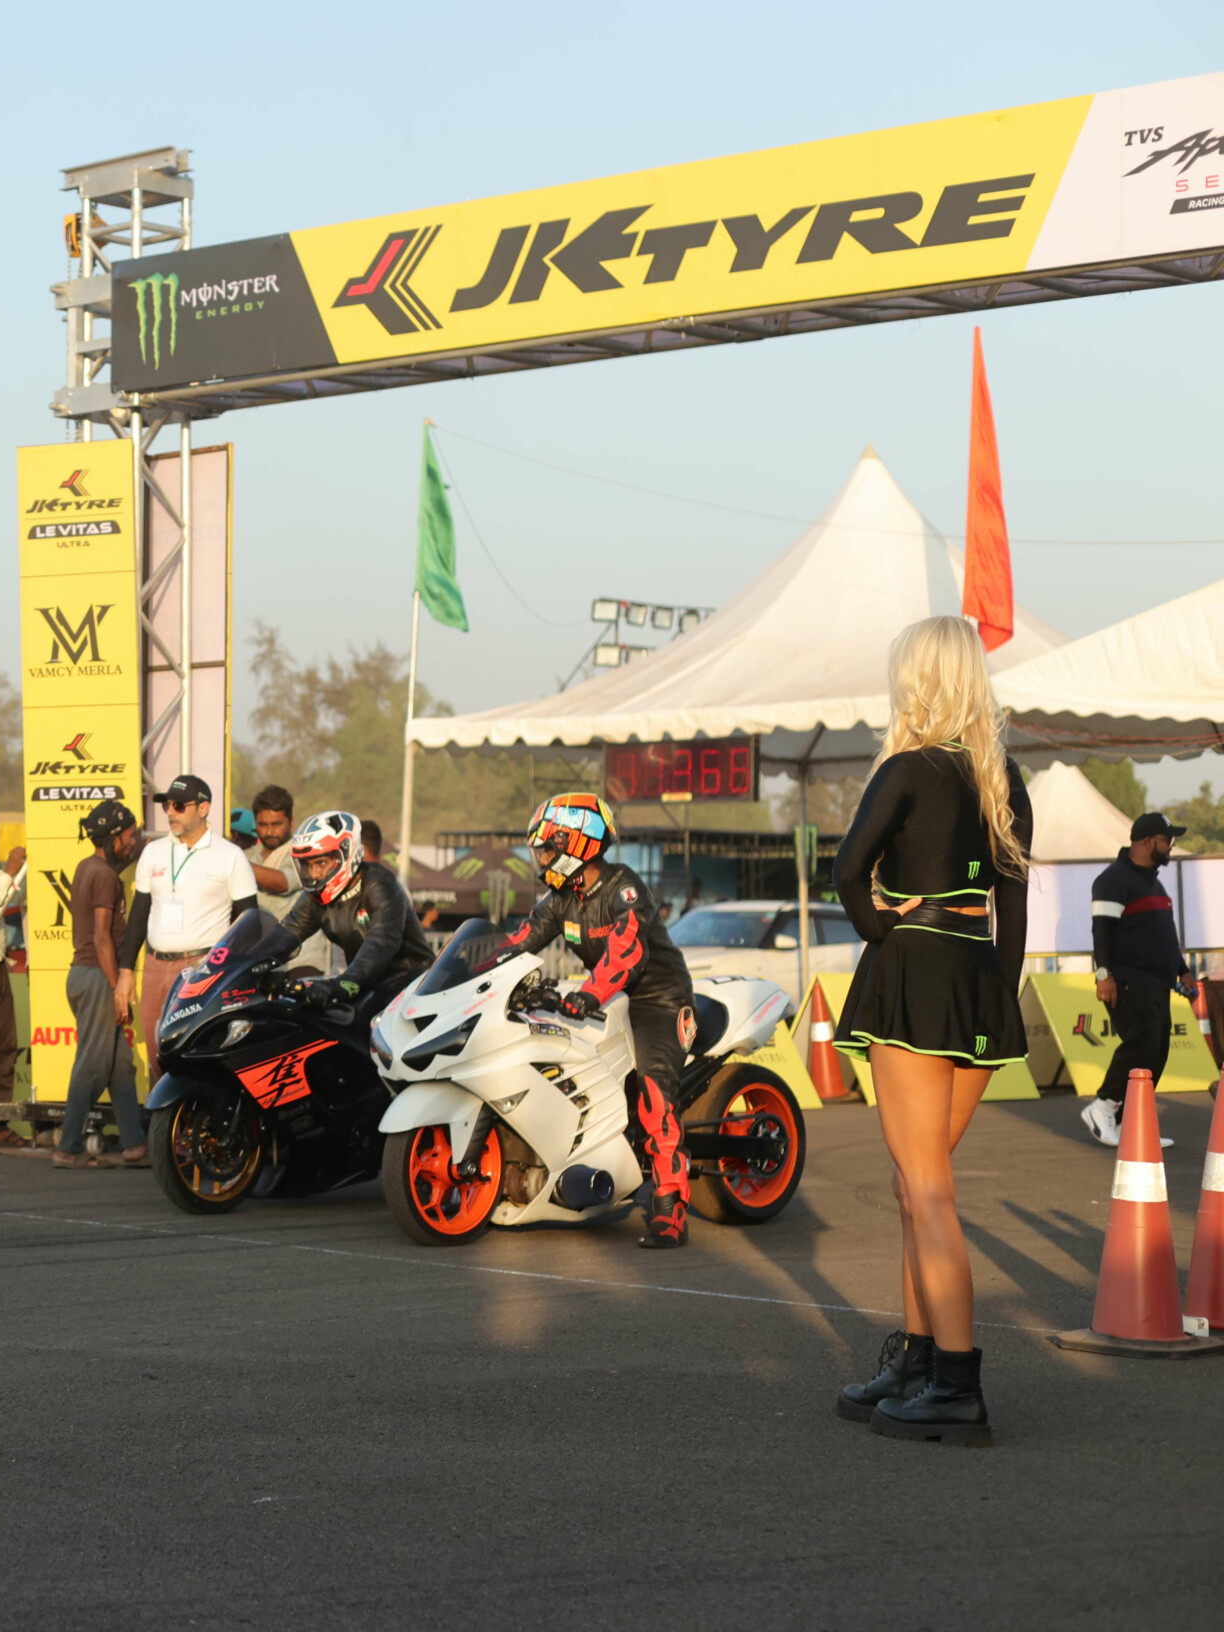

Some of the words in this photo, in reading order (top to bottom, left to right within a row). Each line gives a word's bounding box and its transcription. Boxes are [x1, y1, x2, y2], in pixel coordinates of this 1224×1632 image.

[1124, 126, 1165, 147] TVS
[1121, 128, 1224, 177] Ap
[180, 274, 280, 308] MONSTER
[195, 300, 265, 320] ENERGY
[56, 540, 91, 549] ULTRA
[29, 666, 76, 679] VAMCY
[77, 664, 124, 677] MERLA
[34, 929, 73, 941] VAMC
